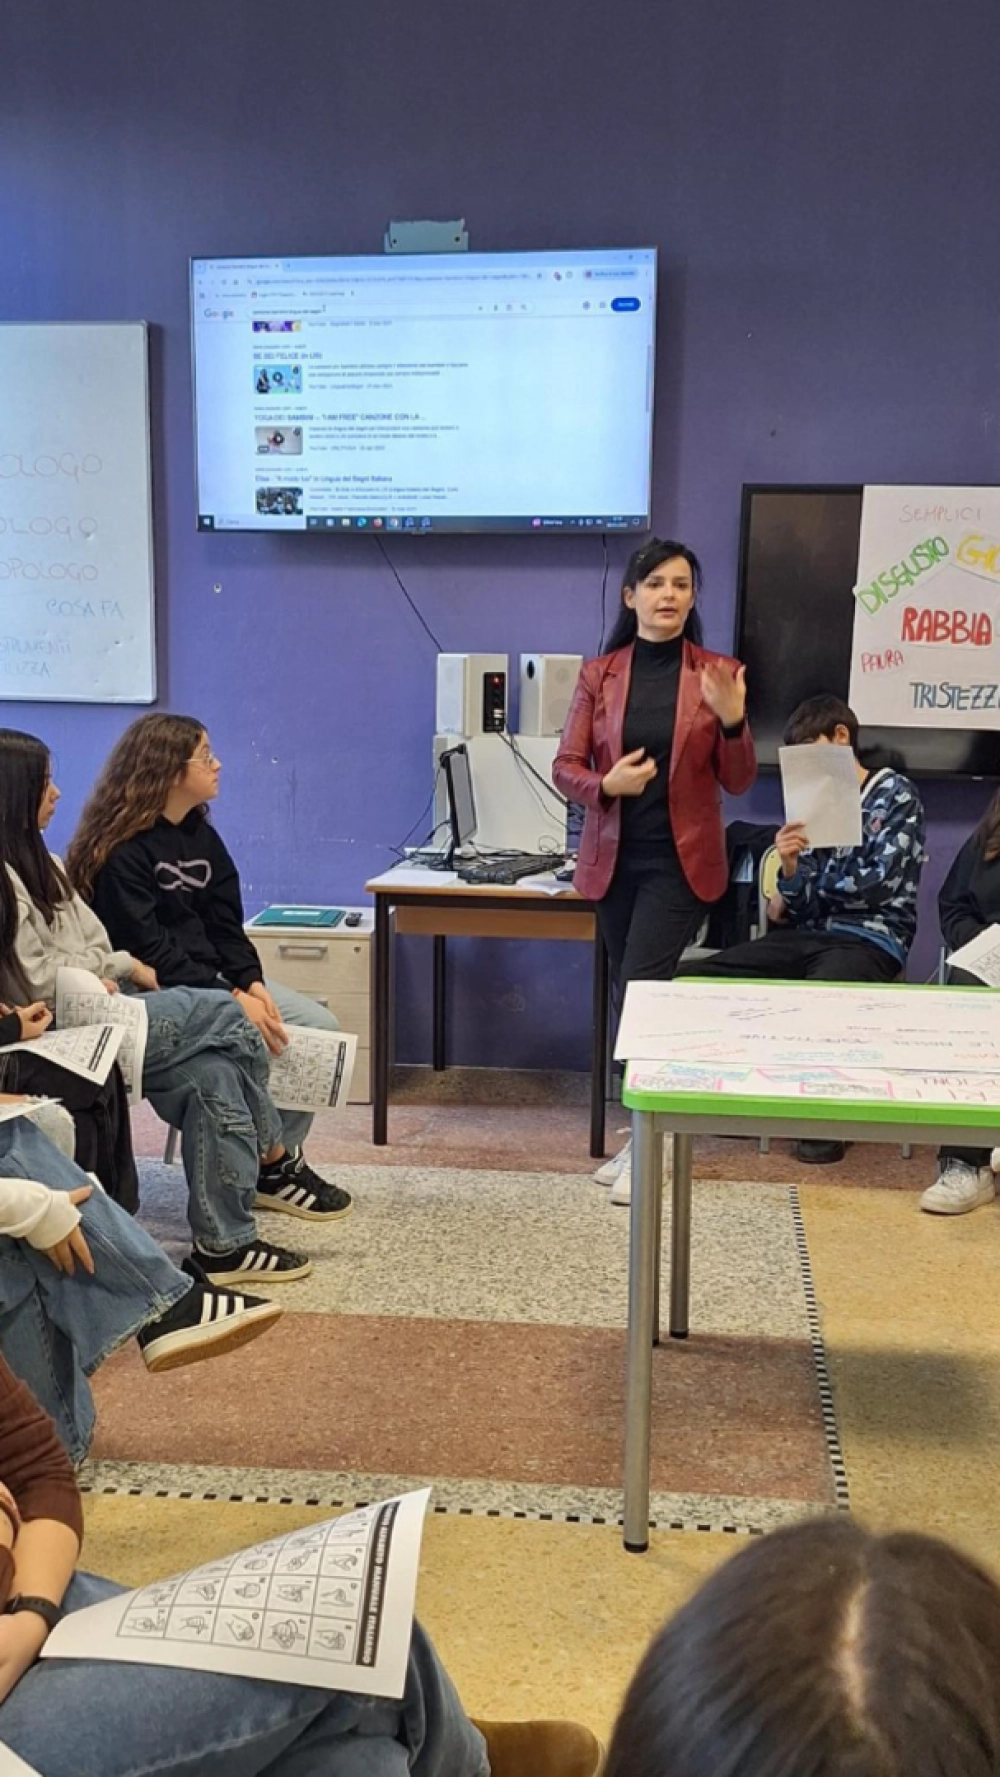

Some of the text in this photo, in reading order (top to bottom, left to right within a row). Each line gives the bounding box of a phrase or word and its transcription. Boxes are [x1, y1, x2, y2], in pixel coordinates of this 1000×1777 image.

[857, 536, 950, 614] DISGUSTO
[101, 601, 125, 620] FA
[901, 606, 992, 646] RABBIA
[861, 649, 905, 672] PAURA
[910, 681, 1000, 710] TRISTEZZ
[362, 1614, 377, 1665] ITALIANO
